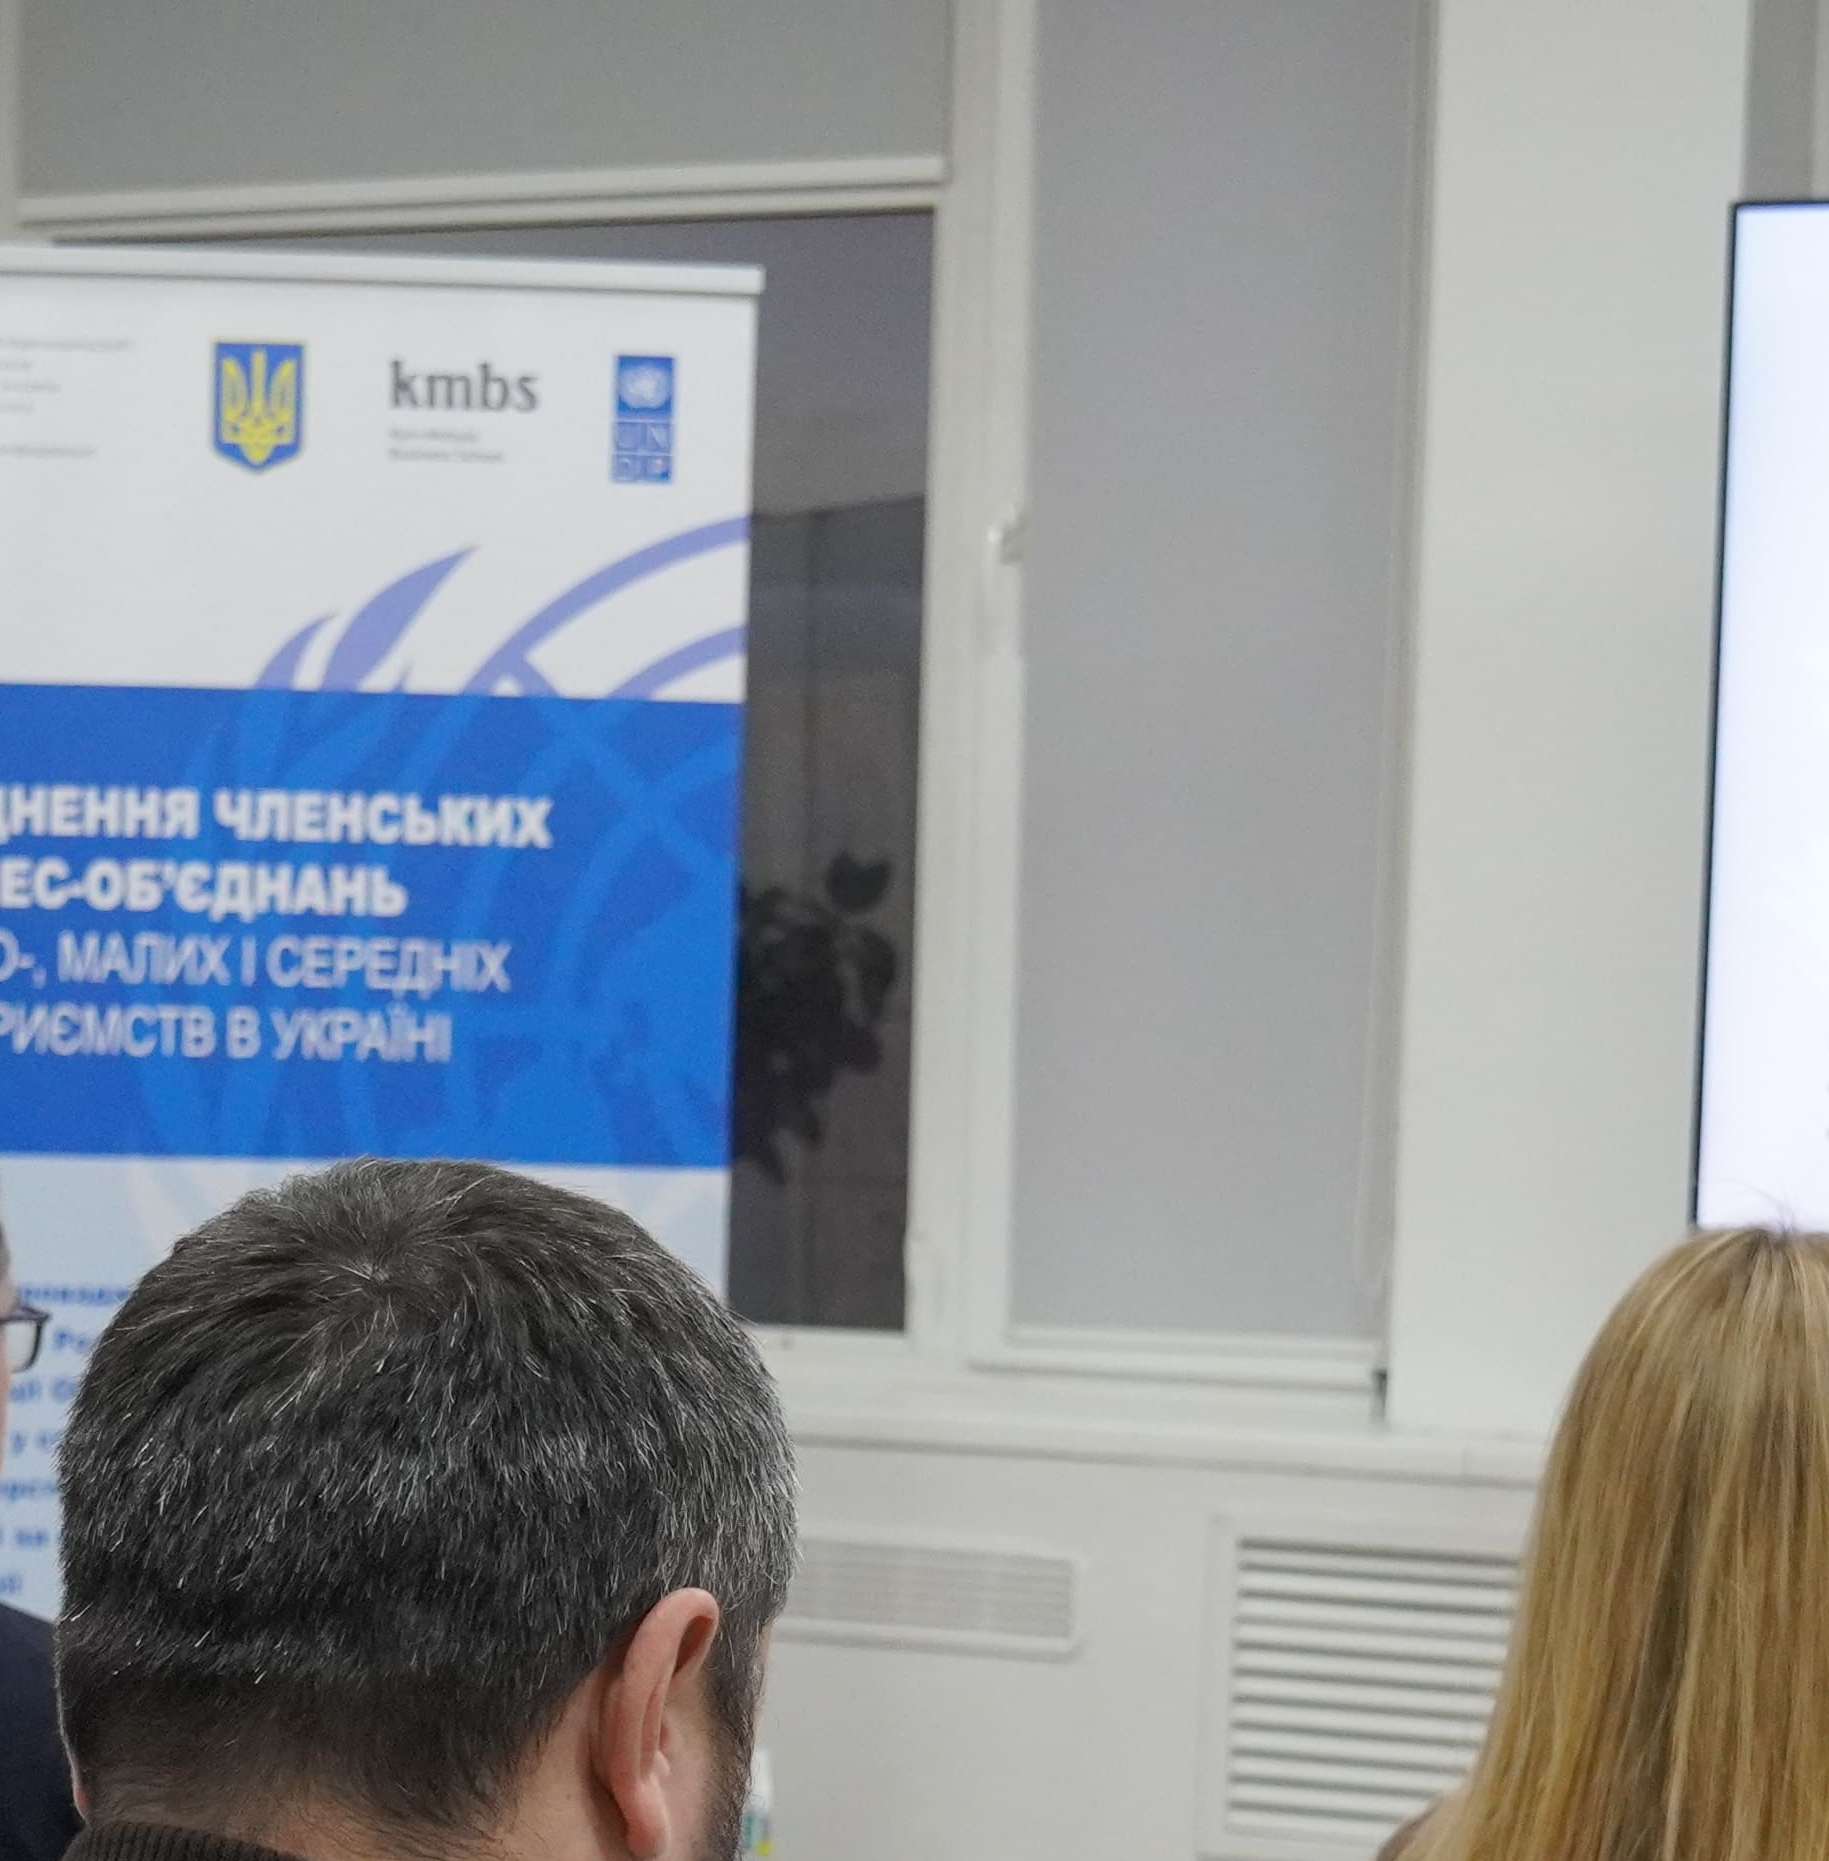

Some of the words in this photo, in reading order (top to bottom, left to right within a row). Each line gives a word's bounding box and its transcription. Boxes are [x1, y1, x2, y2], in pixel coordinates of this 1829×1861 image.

[390, 360, 539, 412] kmbs
[213, 787, 553, 849] ЧЛЕНСЬКИХ
[59, 930, 230, 986] МАЛИХ
[241, 935, 256, 986] І
[266, 936, 512, 998] СЕРЕДНІХ
[227, 1007, 261, 1059] В
[272, 1004, 452, 1063] УКРАЇНІ
